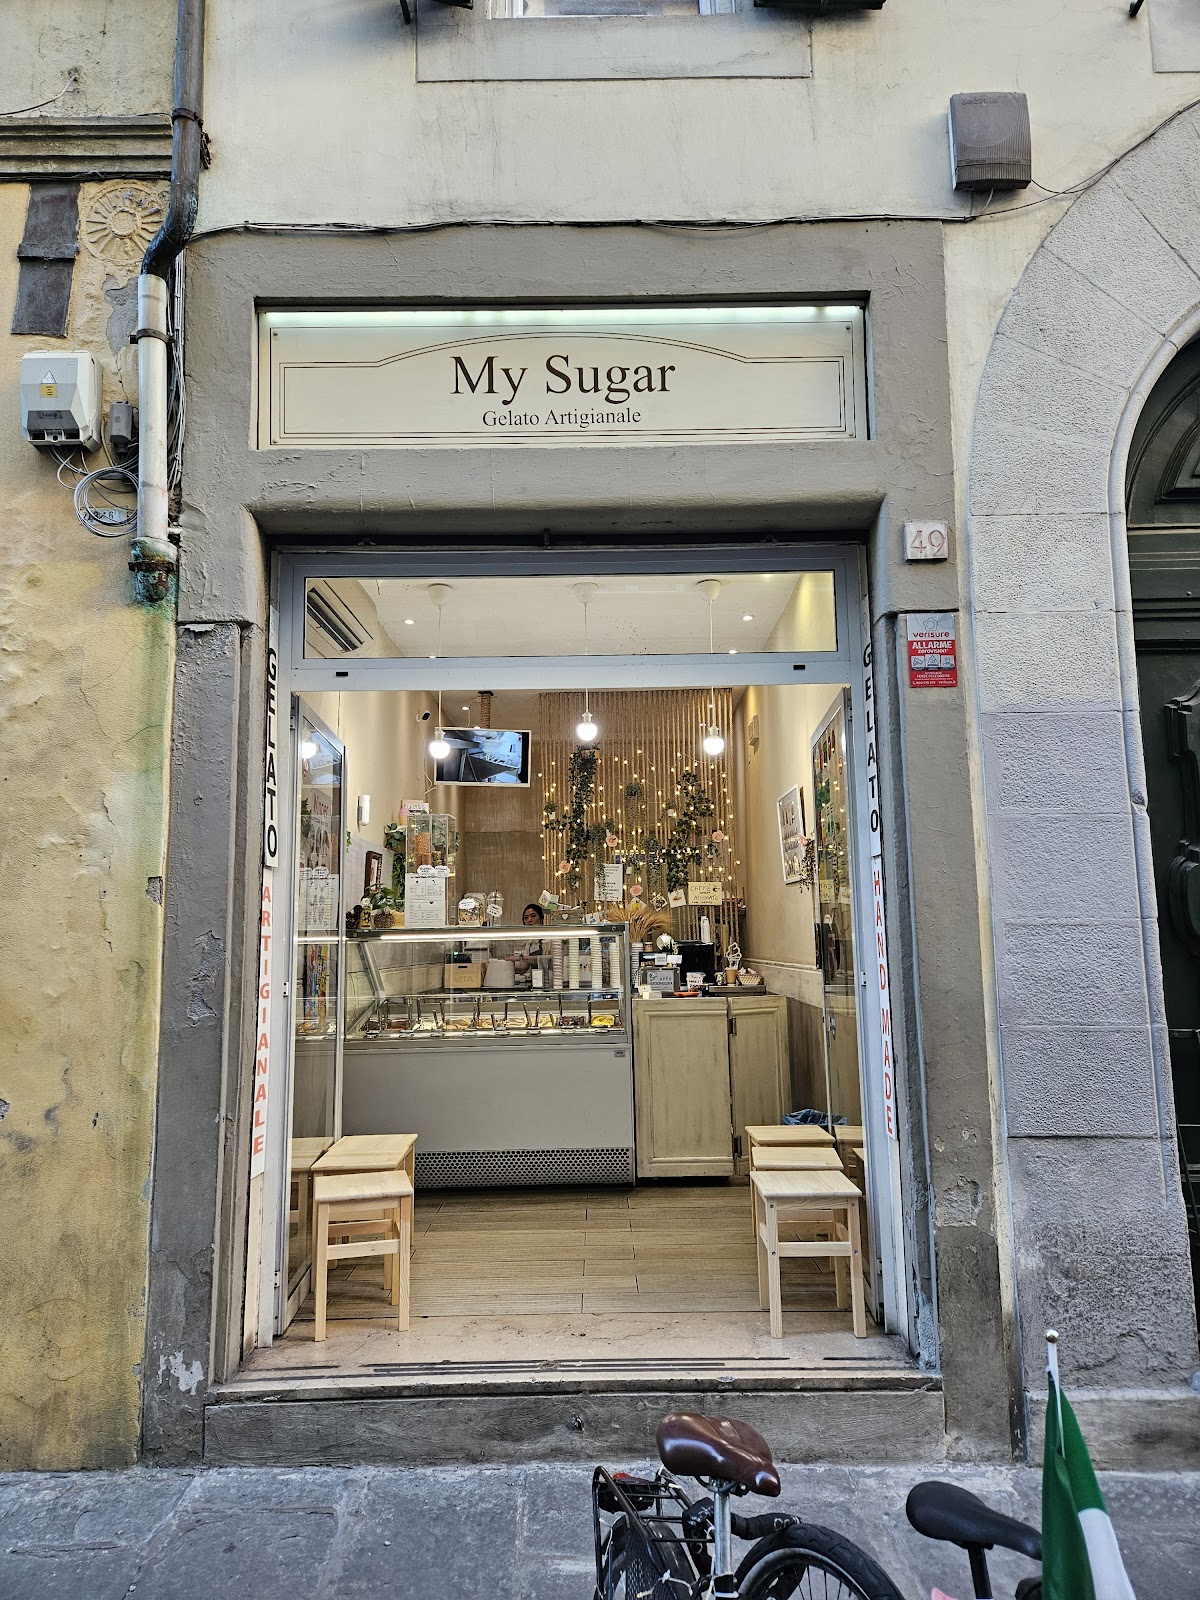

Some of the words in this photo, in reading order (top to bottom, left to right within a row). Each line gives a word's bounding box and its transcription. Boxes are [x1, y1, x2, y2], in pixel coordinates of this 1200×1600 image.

[450, 355, 529, 405] My
[545, 354, 677, 405] Sugar
[482, 409, 540, 427] Gelato
[544, 408, 642, 428] Artigianale
[909, 529, 946, 557] 49
[912, 641, 952, 649] ALLARME
[267, 647, 277, 858] GELATO
[863, 642, 879, 833] GELATO
[253, 886, 271, 1155] ARTIGIANALE
[873, 870, 887, 991] HAND
[881, 1008, 893, 1135] MADE
